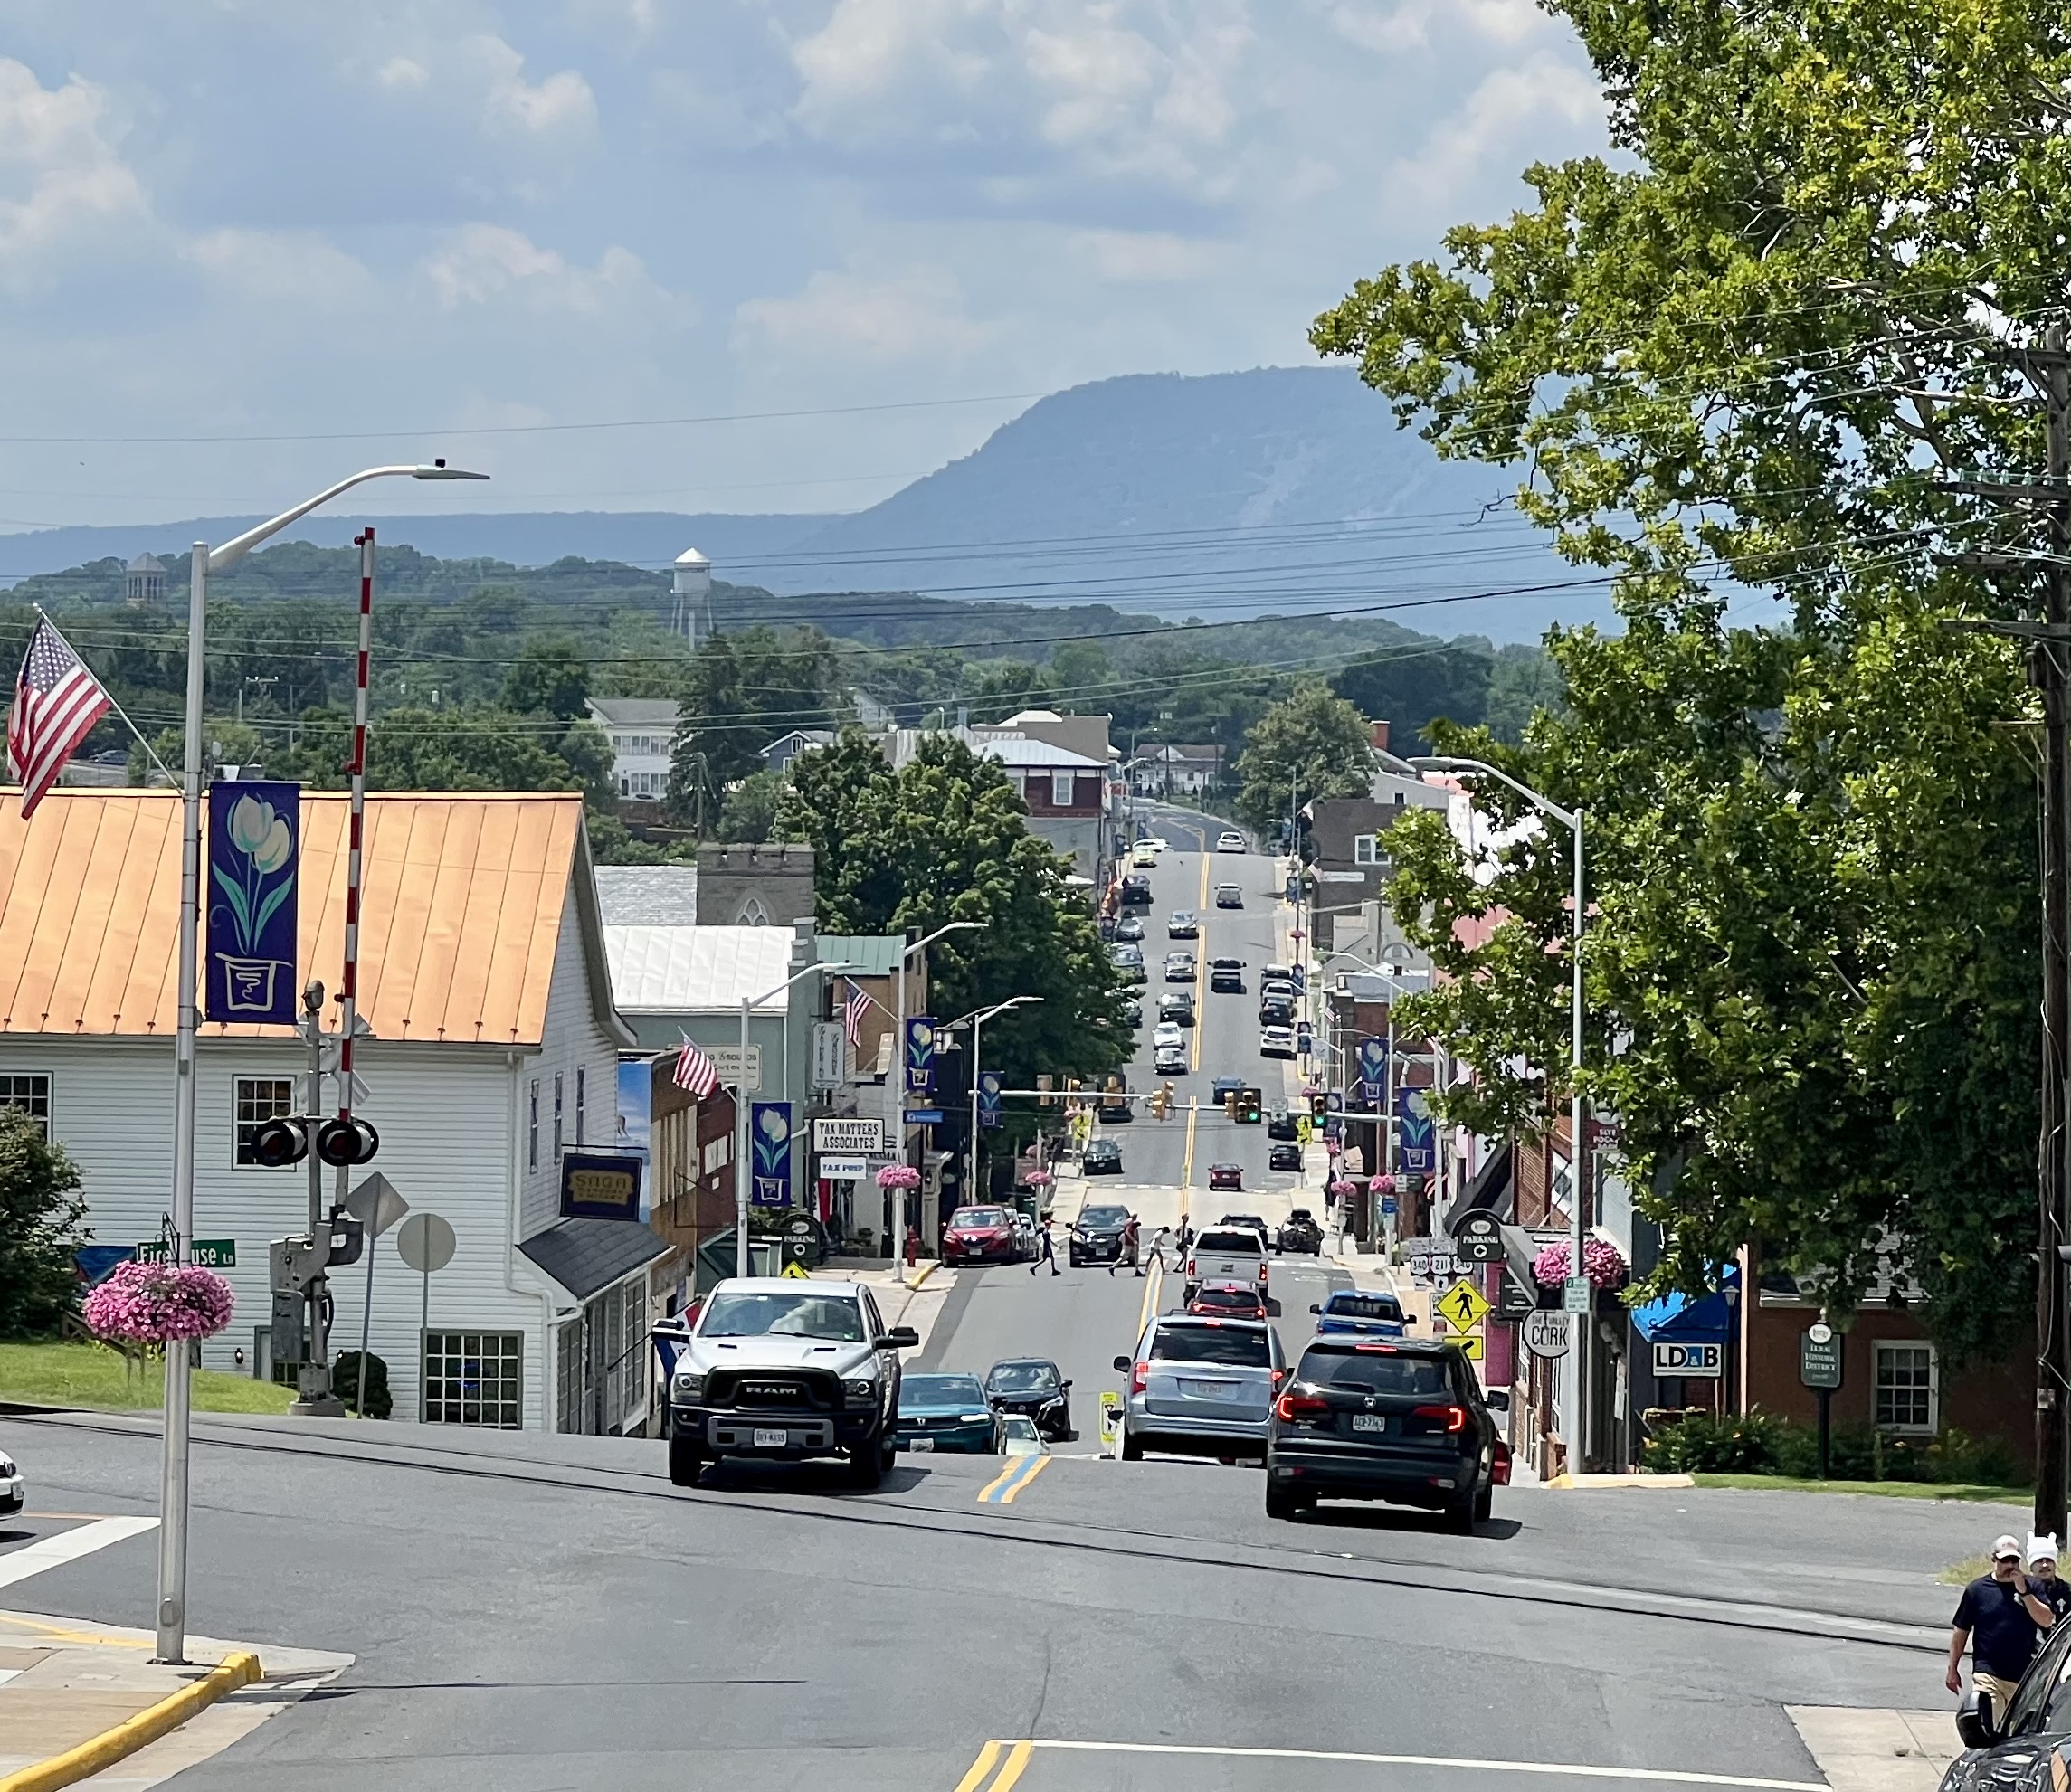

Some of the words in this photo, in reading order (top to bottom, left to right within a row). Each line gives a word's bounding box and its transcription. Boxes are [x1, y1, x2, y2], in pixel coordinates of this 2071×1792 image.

[819, 1123, 836, 1135] TAX
[838, 1123, 879, 1136] MATTERS
[822, 1137, 875, 1149] ASSOCIATES
[784, 1235, 816, 1243] PARKING
[1462, 1235, 1499, 1244] PARKING
[223, 1253, 233, 1265] Ln
[1412, 1260, 1427, 1271] 340
[1435, 1260, 1448, 1270] 211
[1532, 1325, 1568, 1346] CORK
